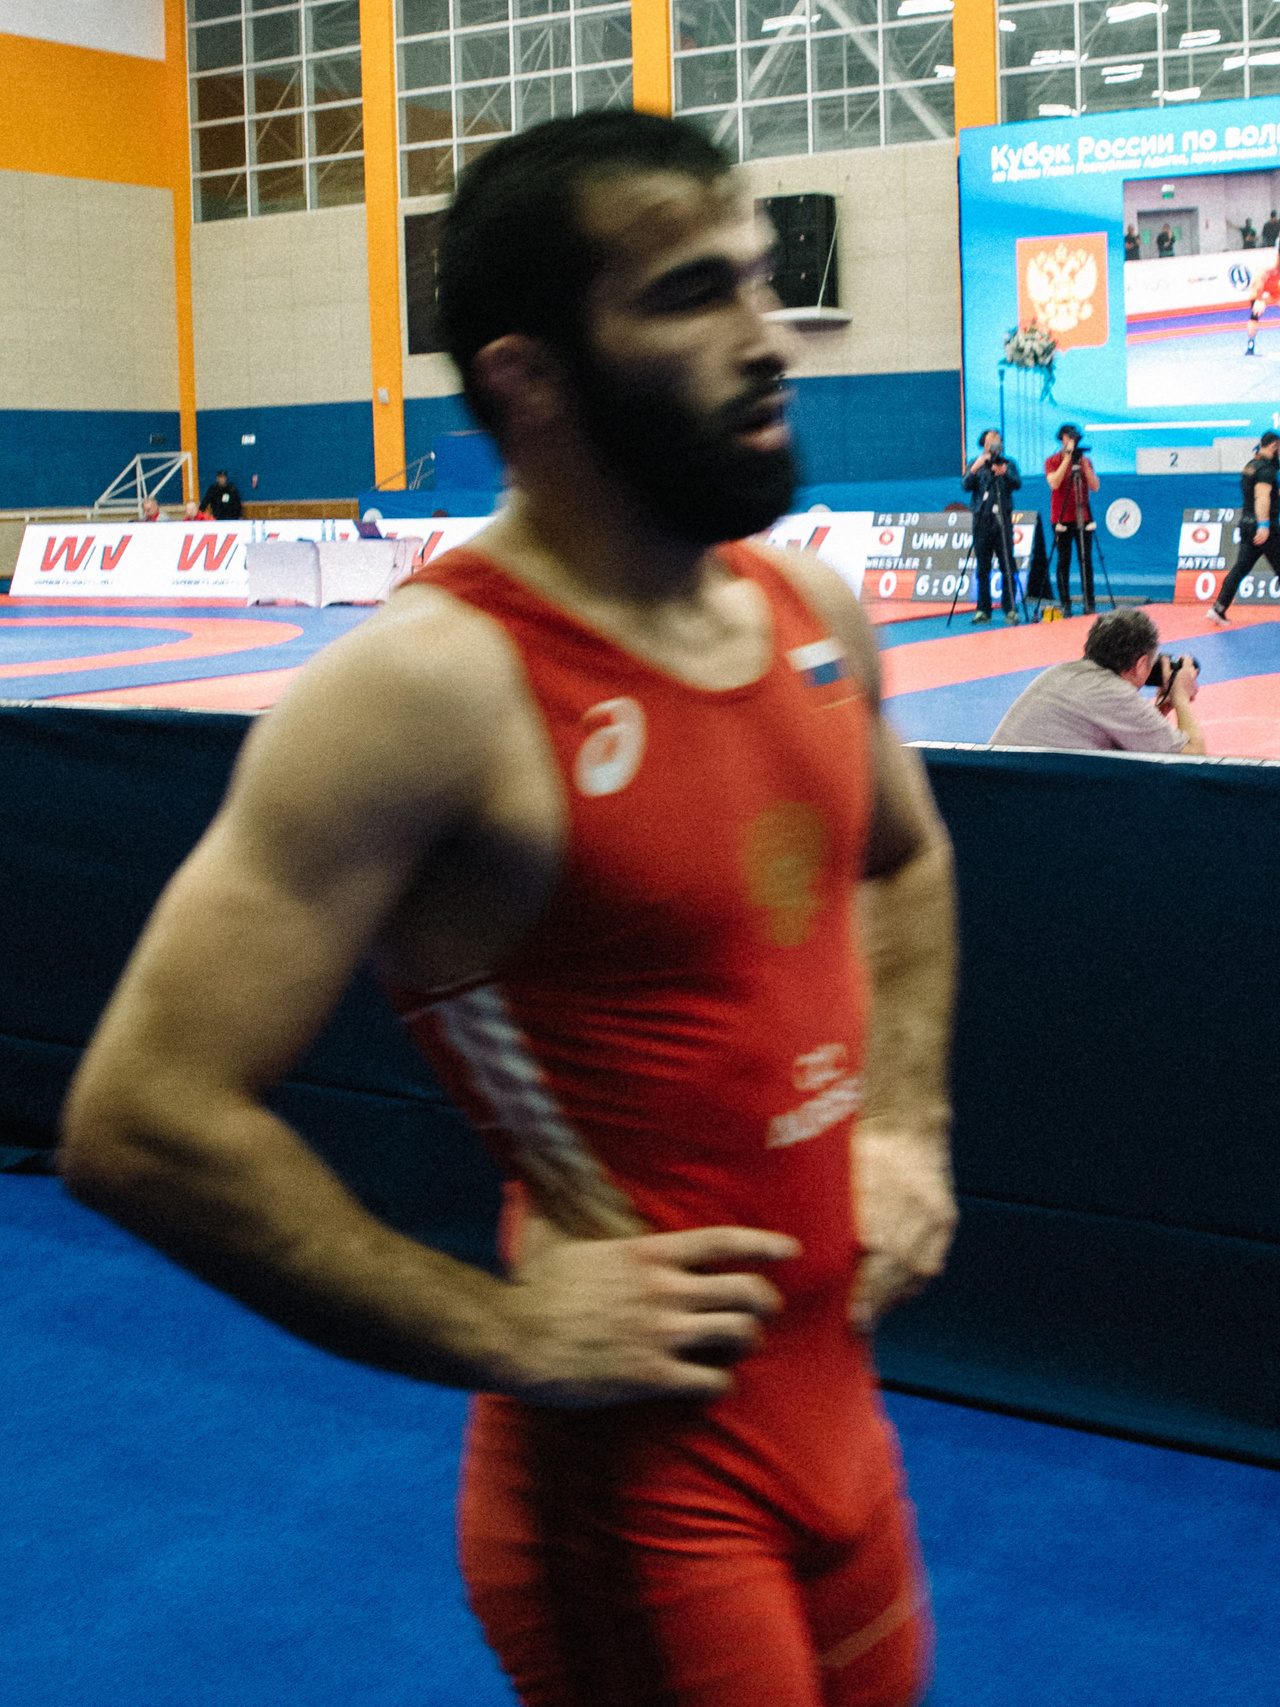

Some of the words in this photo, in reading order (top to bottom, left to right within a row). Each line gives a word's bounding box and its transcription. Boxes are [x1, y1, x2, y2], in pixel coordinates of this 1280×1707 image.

[991, 142, 1070, 171] Кубок
[1078, 133, 1174, 161] России
[1182, 128, 1217, 151] по
[1169, 452, 1178, 468] 2
[1216, 508, 1234, 523] 70
[911, 532, 948, 549] UWW
[879, 571, 897, 598] 0
[916, 574, 969, 597] 6:00
[1195, 571, 1216, 600] 0
